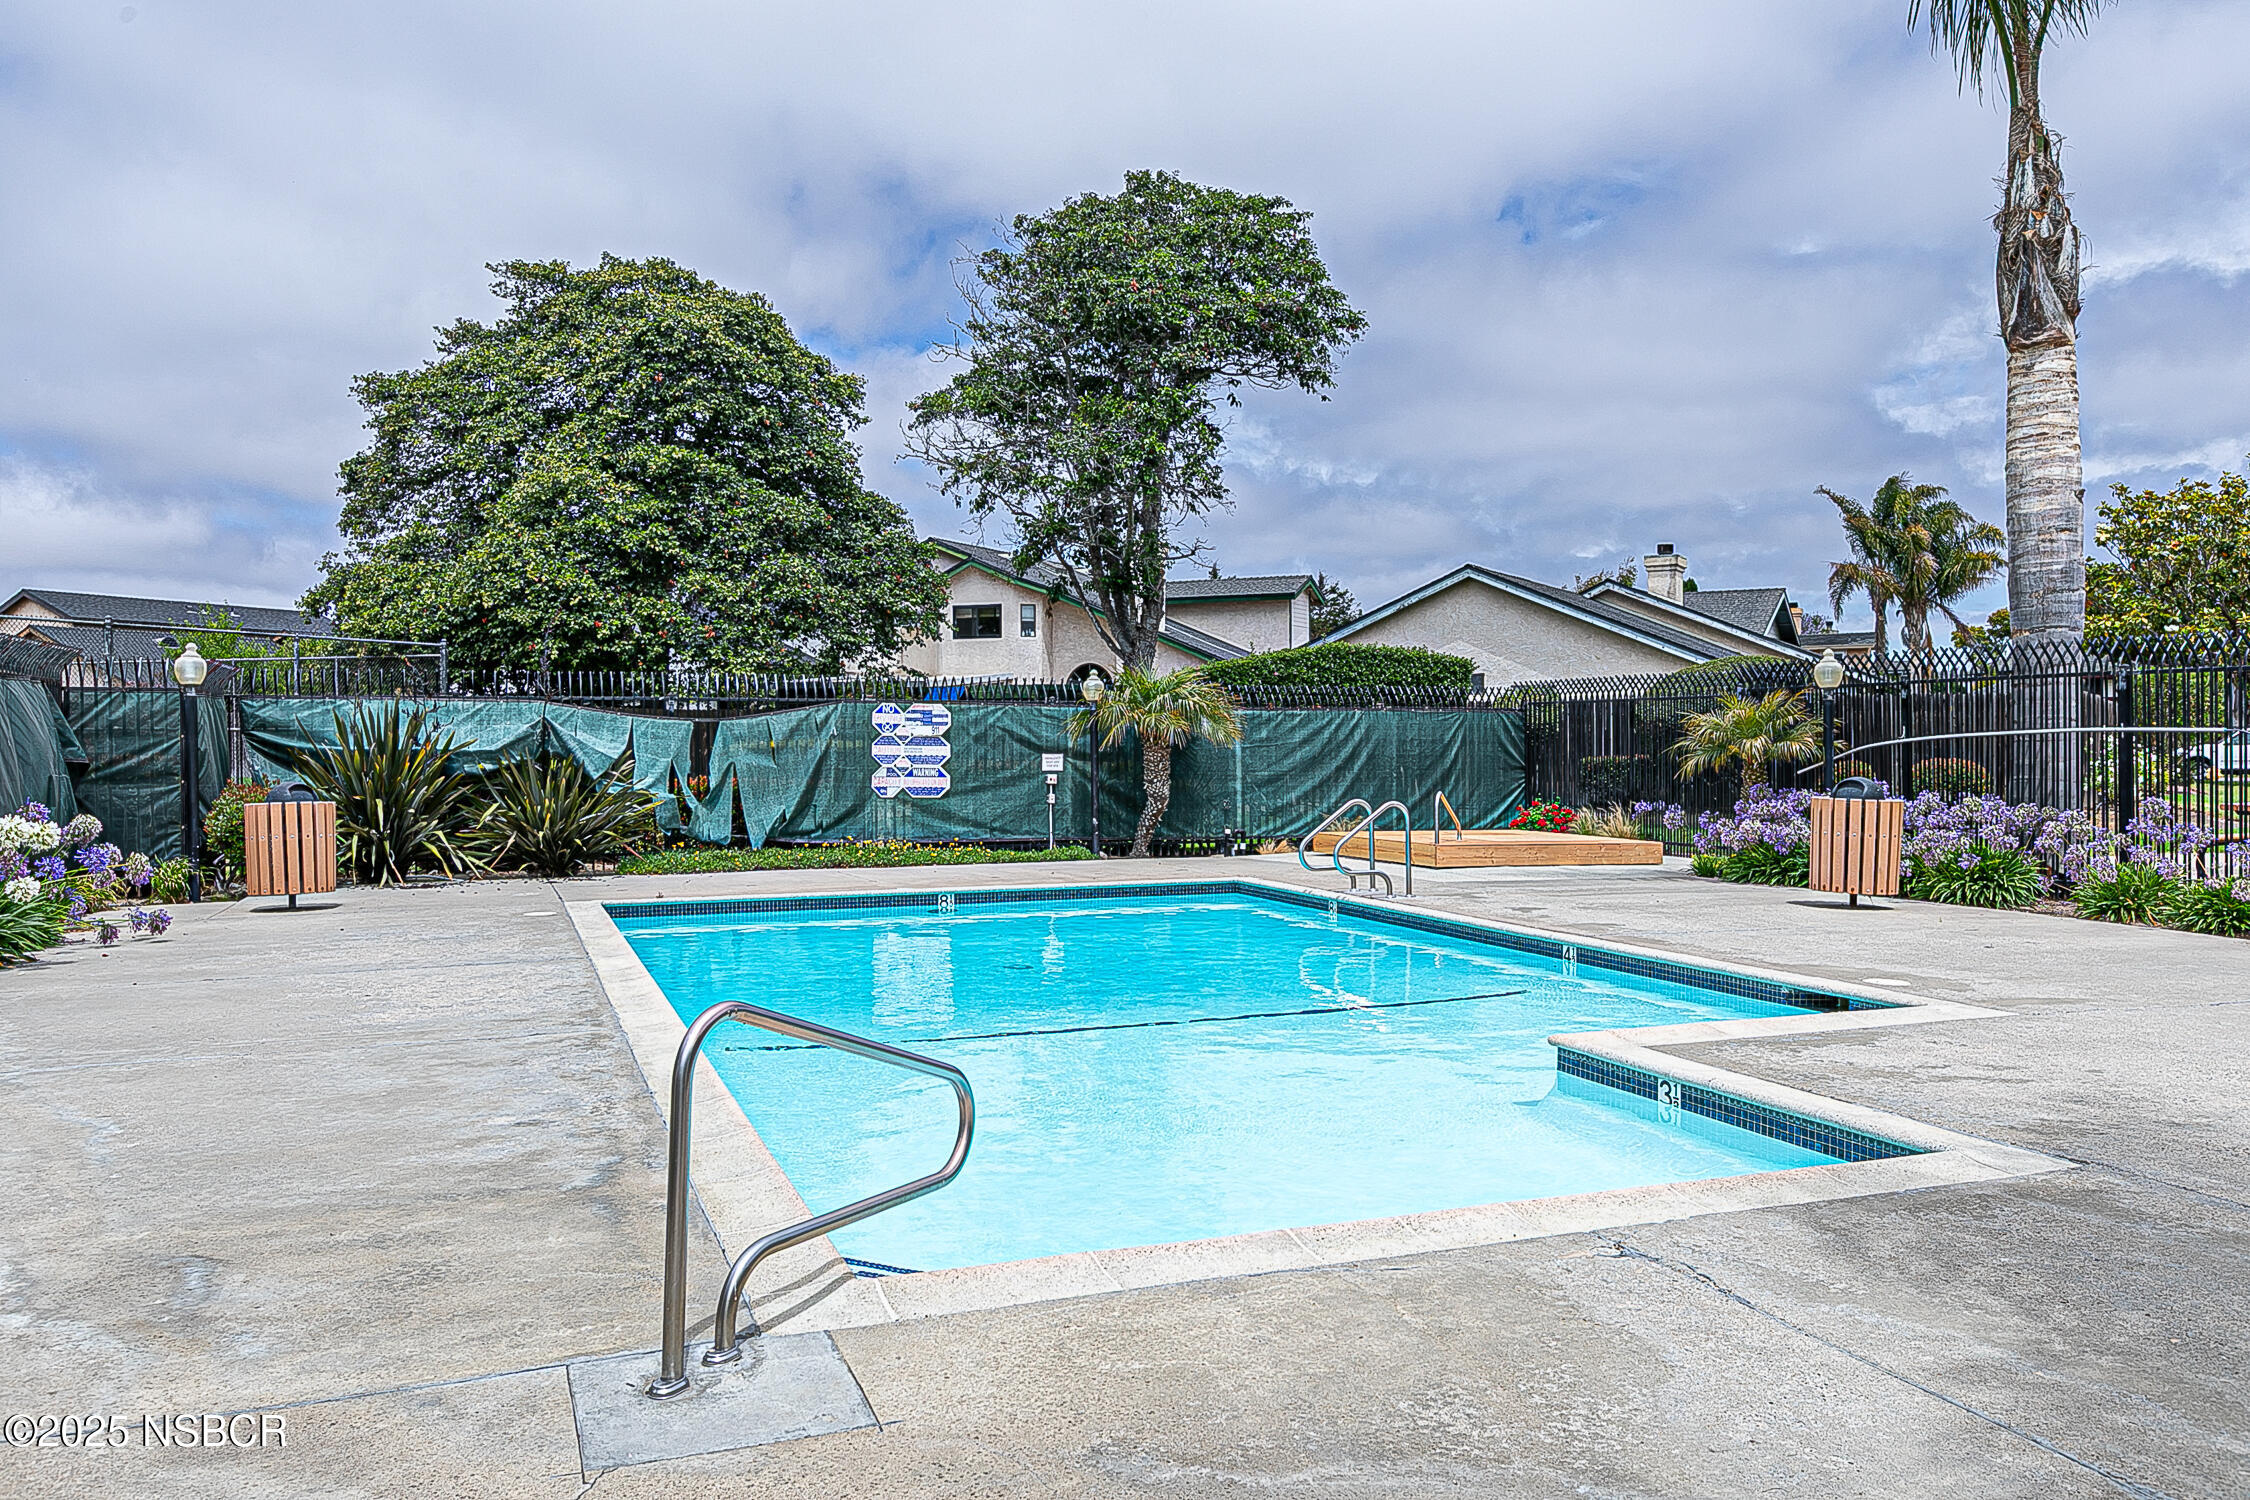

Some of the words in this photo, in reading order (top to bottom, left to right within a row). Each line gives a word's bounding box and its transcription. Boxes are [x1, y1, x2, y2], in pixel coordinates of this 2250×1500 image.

[882, 704, 895, 714] NO
[931, 726, 940, 734] 911
[913, 768, 939, 777] WARNING
[940, 894, 949, 908] 8
[1563, 946, 1571, 961] 4
[1659, 1080, 1672, 1105] 3
